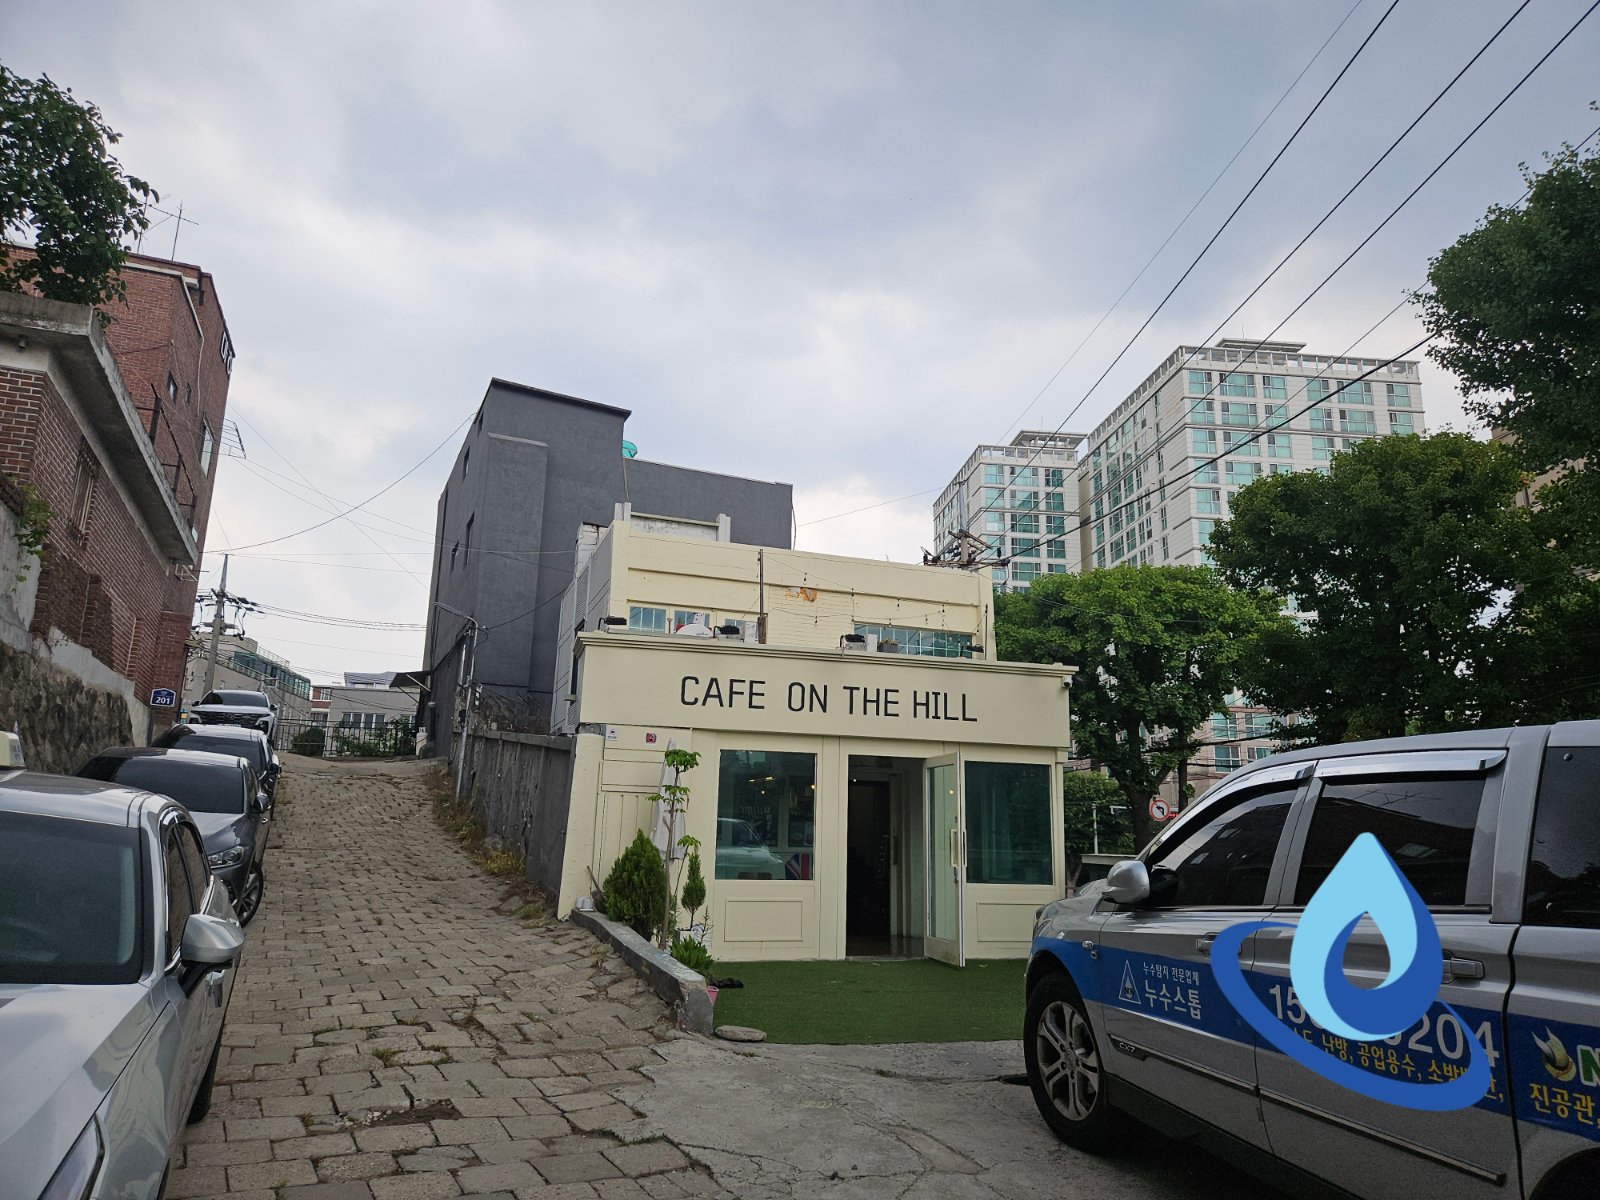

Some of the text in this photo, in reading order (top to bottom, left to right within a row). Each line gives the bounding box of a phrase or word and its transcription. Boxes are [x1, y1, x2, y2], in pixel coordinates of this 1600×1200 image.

[156, 697, 170, 705] 201
[680, 676, 978, 722] CAFE ON THE HILL
[1143, 962, 1200, 986] 누수탐지 전문업체
[1145, 979, 1202, 1020] 누수스톱
[1358, 1042, 1422, 1081] 공업용수,
